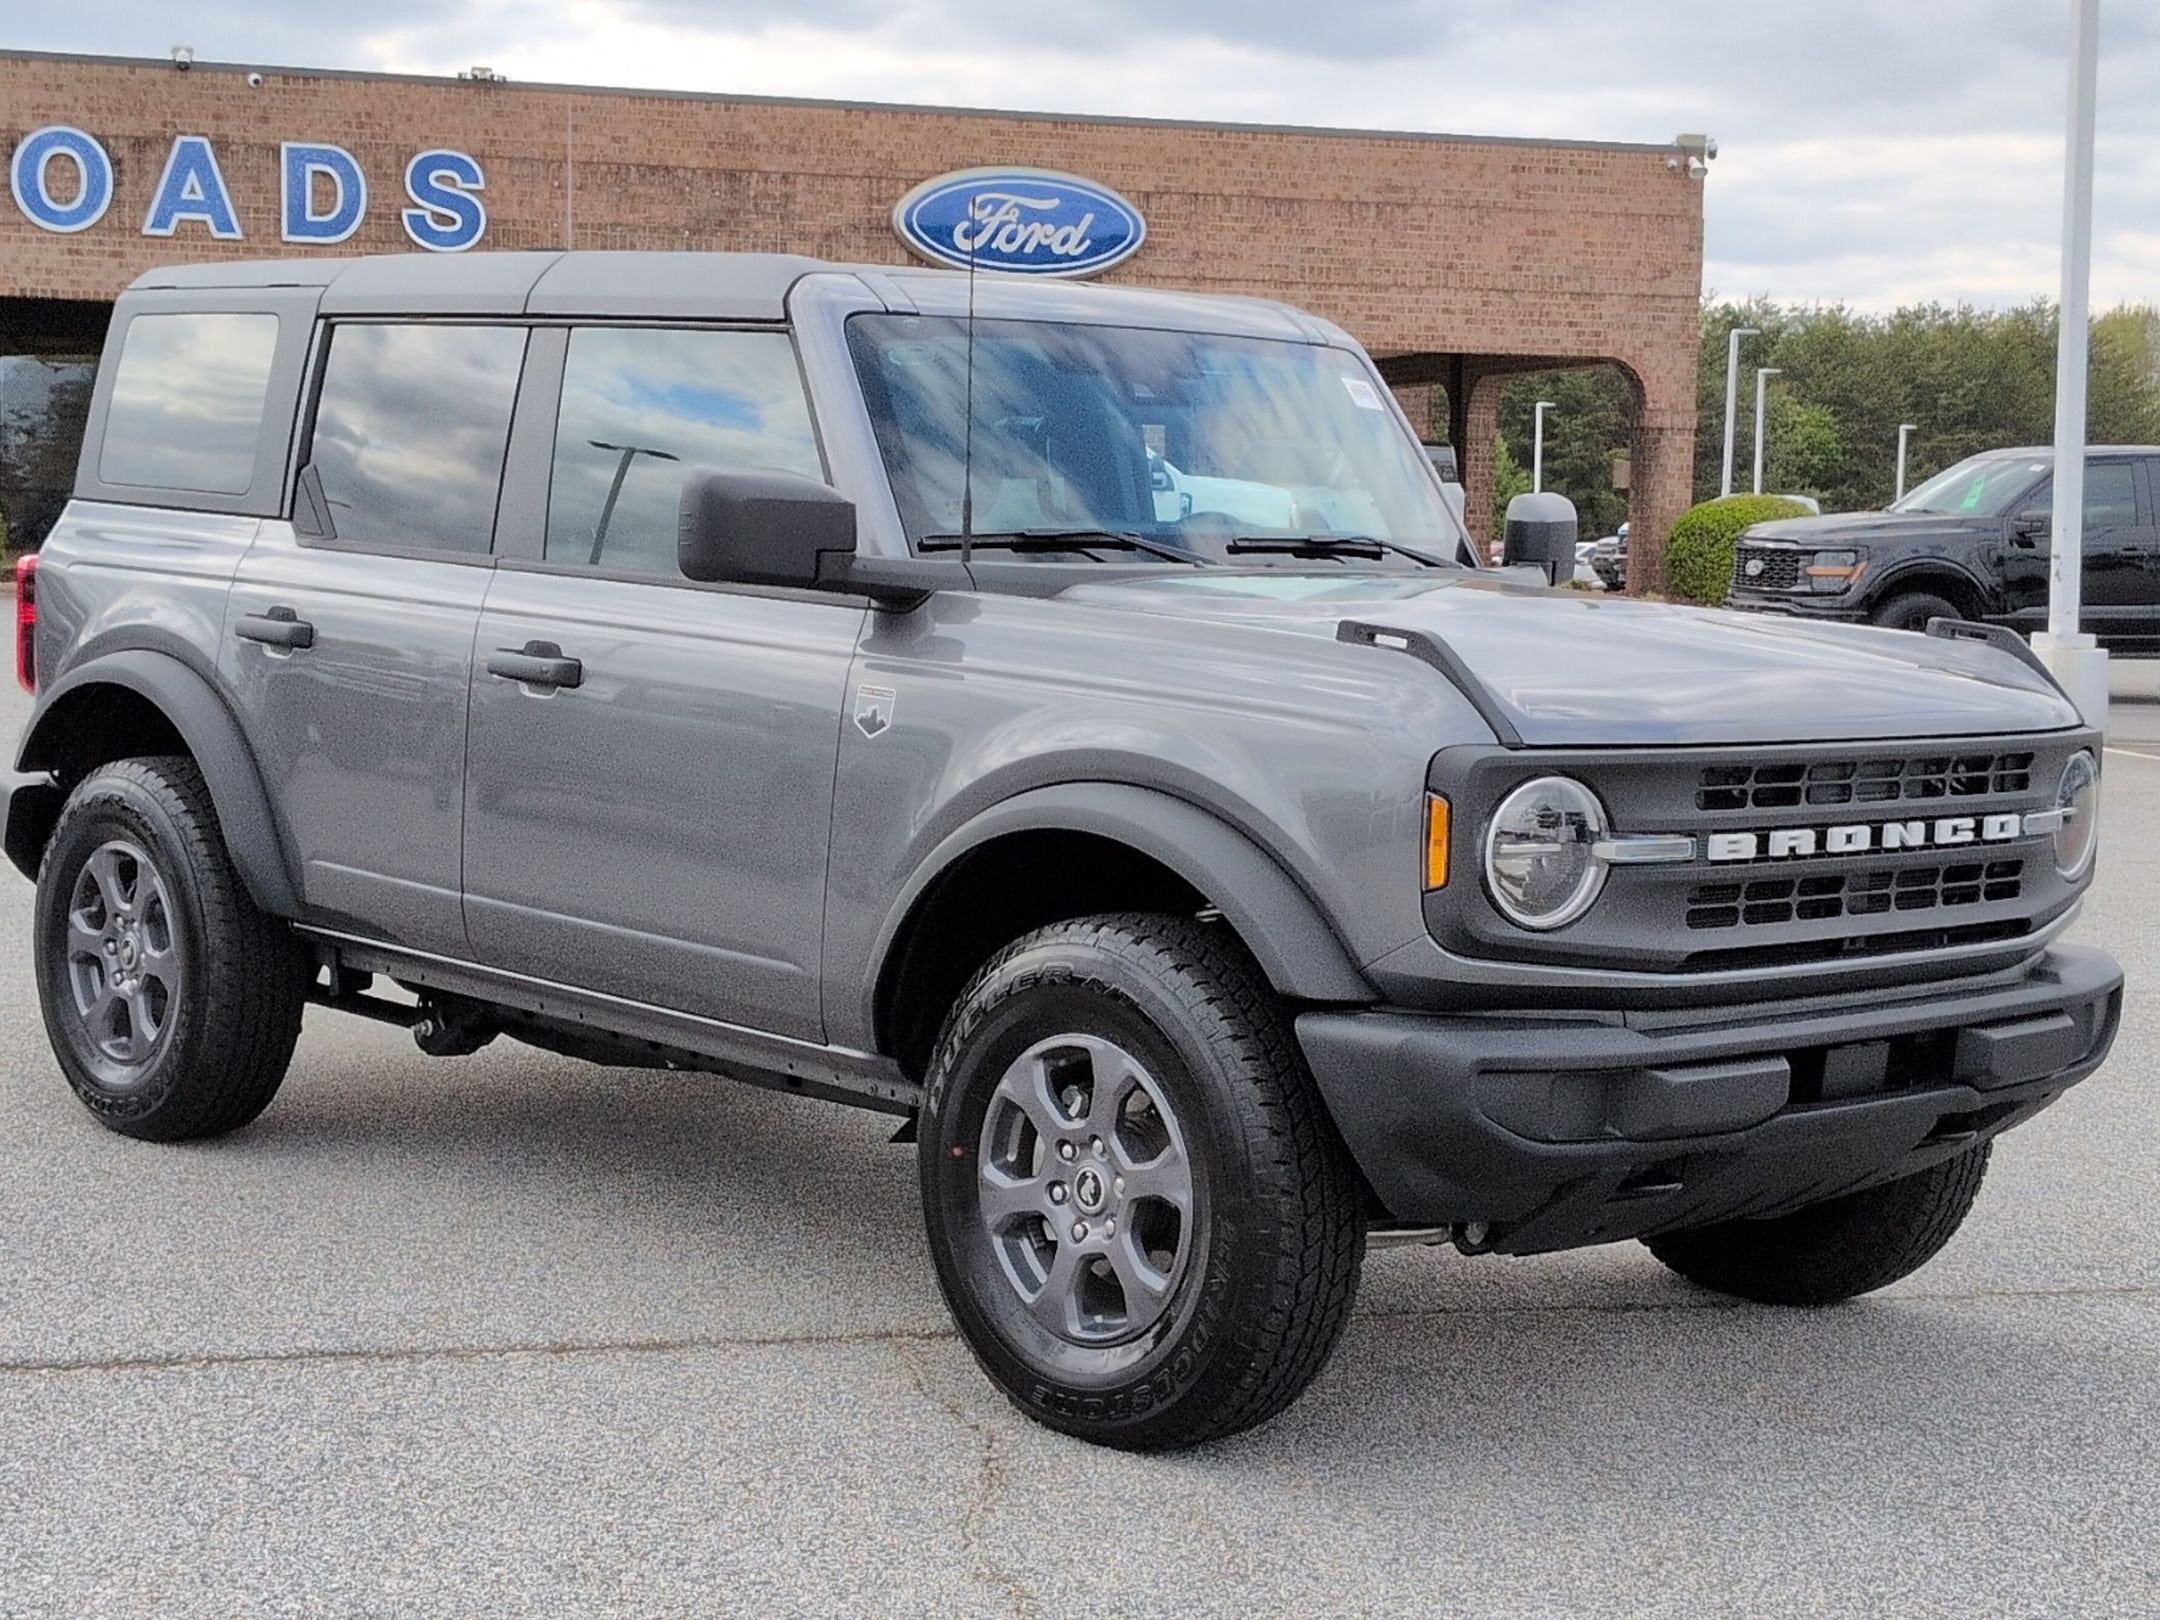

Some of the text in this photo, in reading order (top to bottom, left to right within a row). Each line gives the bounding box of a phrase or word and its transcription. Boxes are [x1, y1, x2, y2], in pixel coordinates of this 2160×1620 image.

[10, 125, 487, 252] OADS
[952, 192, 1092, 255] Ford
[1707, 813, 2021, 862] BRONCO
